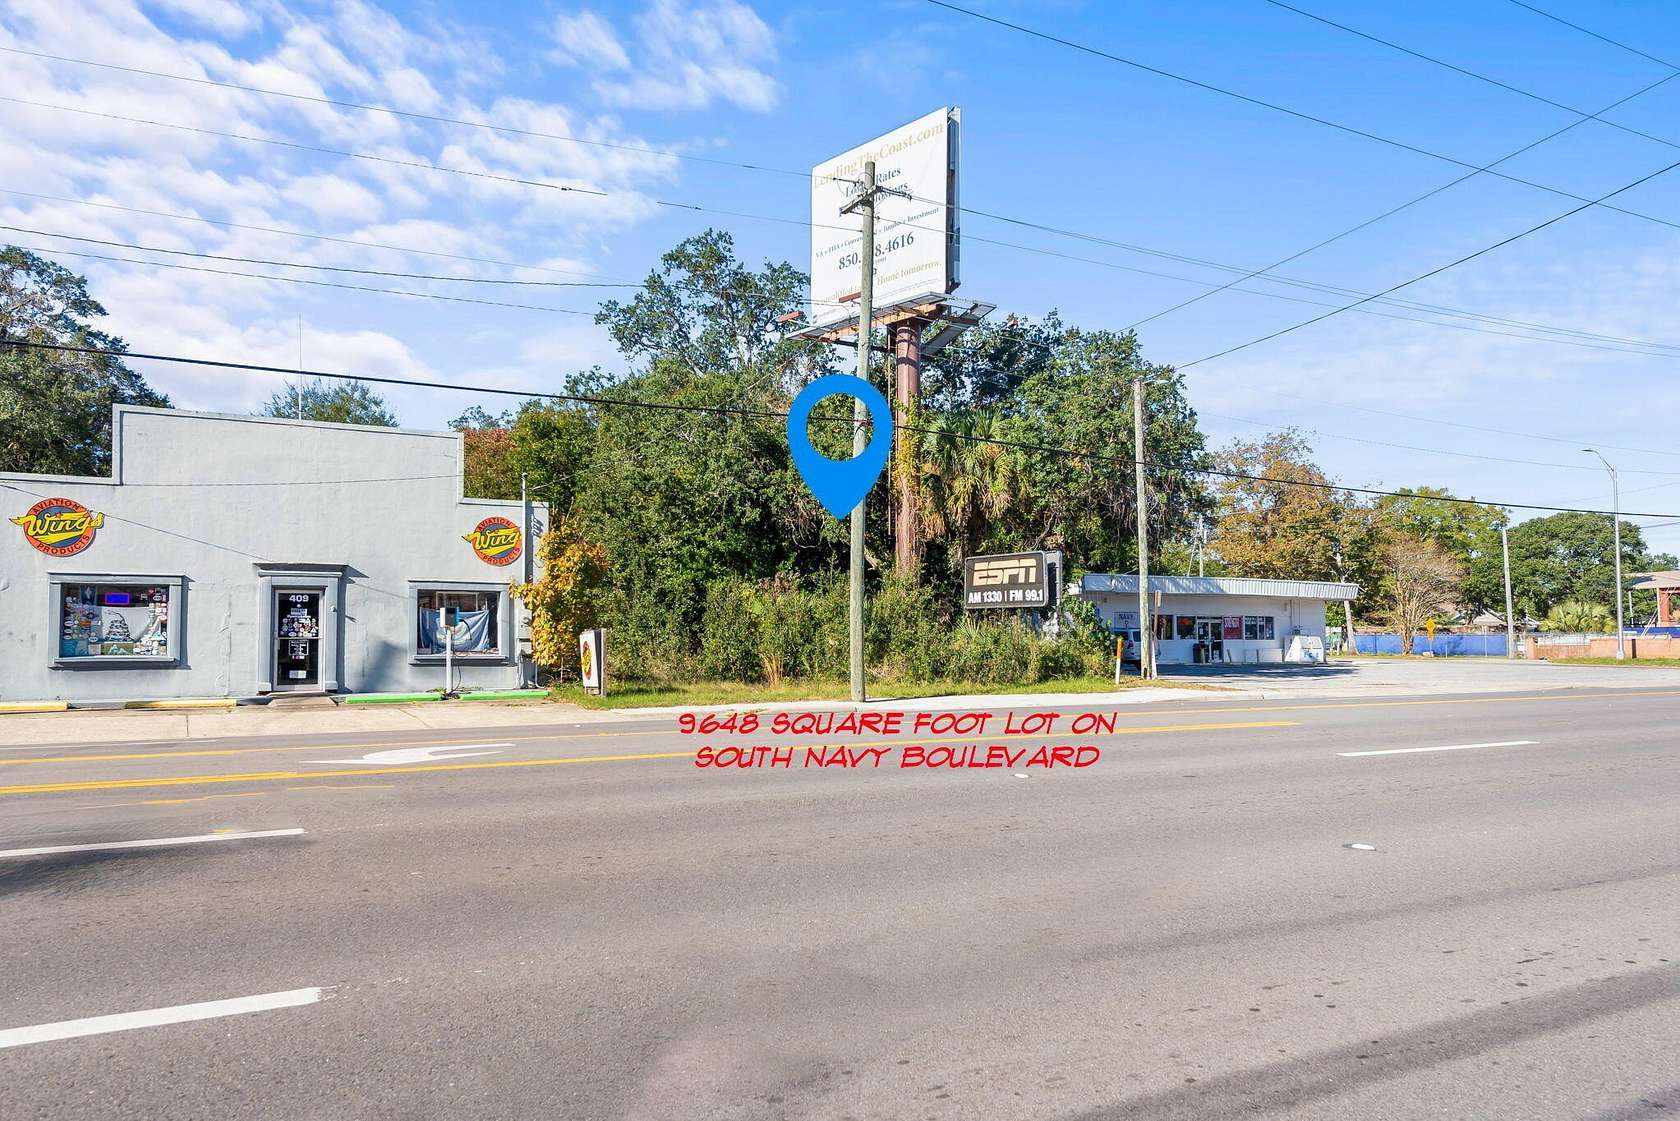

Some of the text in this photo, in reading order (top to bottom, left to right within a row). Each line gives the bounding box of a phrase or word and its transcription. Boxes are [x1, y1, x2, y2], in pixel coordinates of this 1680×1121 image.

[876, 168, 902, 186] Rates
[838, 231, 914, 270] 850.8.4616
[34, 499, 81, 515] AVIATION
[8, 511, 105, 545] Wings
[478, 517, 513, 531] AVIATION
[37, 535, 90, 555] PRODUCTS
[461, 527, 521, 556] Wing
[482, 547, 521, 565] PRODUCTS
[973, 558, 1037, 587] ESPN
[968, 589, 1043, 604] AM 1330 FM 99.1
